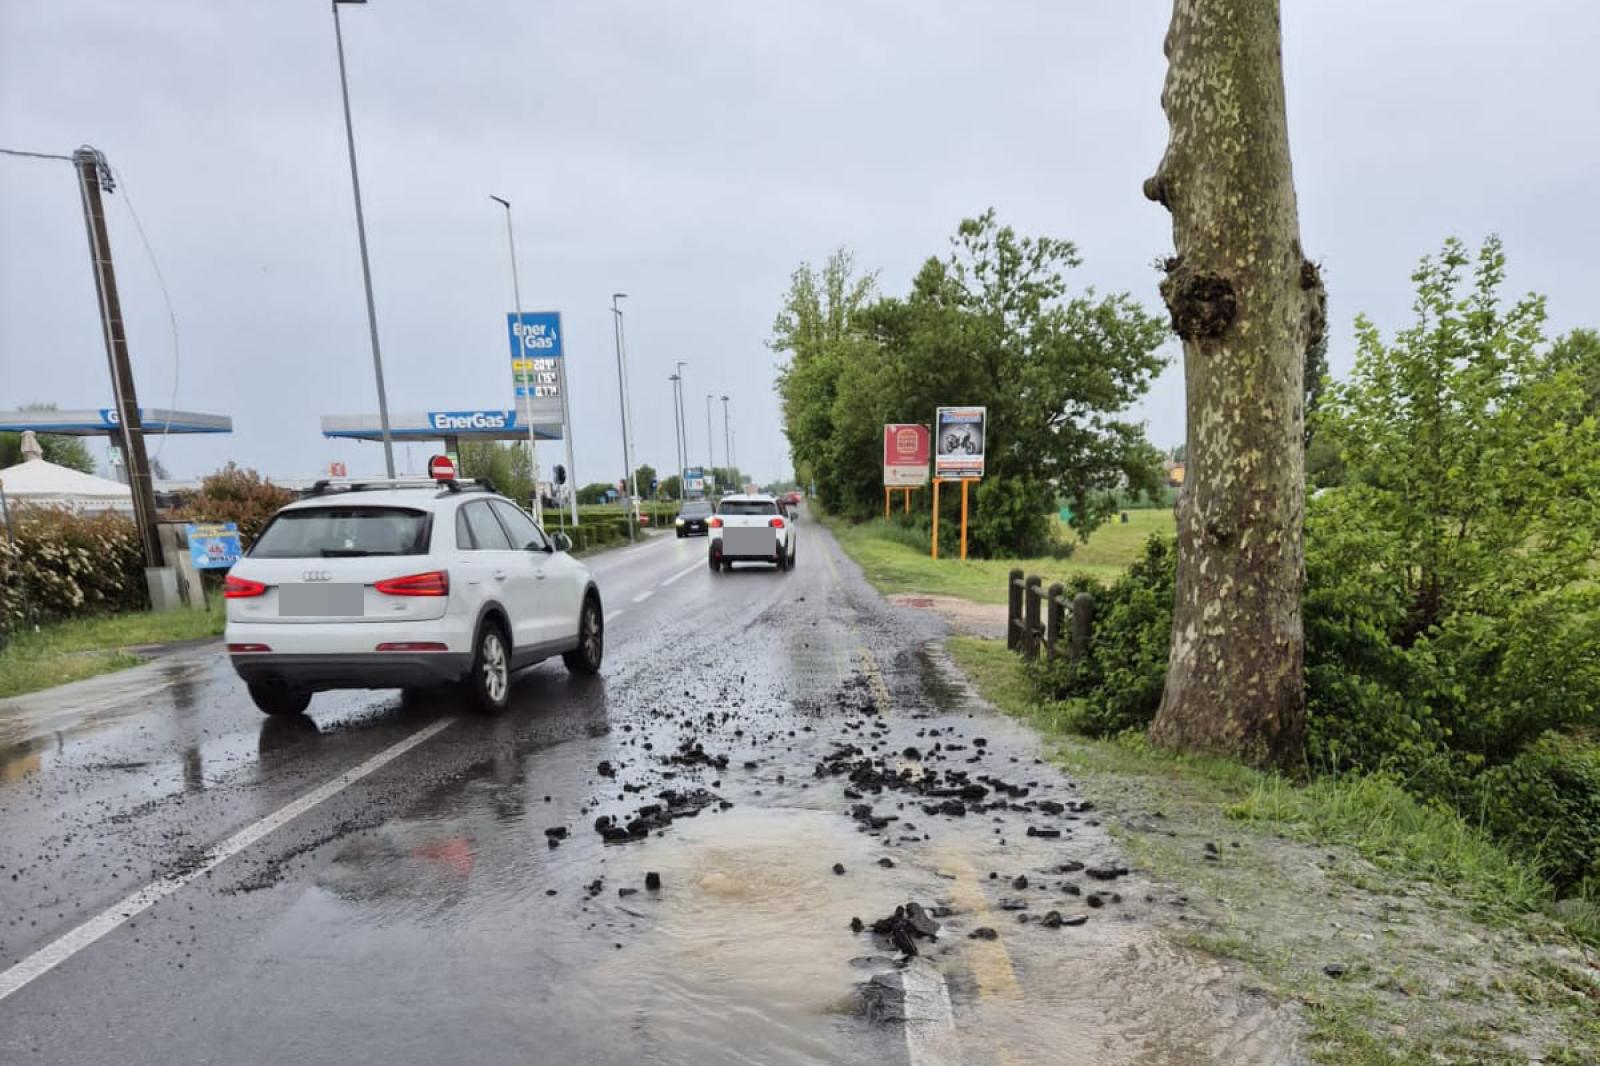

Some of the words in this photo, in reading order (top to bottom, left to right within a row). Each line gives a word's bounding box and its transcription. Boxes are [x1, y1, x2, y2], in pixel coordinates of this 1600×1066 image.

[513, 322, 546, 336] Ener
[525, 335, 553, 349] Gas
[435, 412, 505, 429] EnerGas
